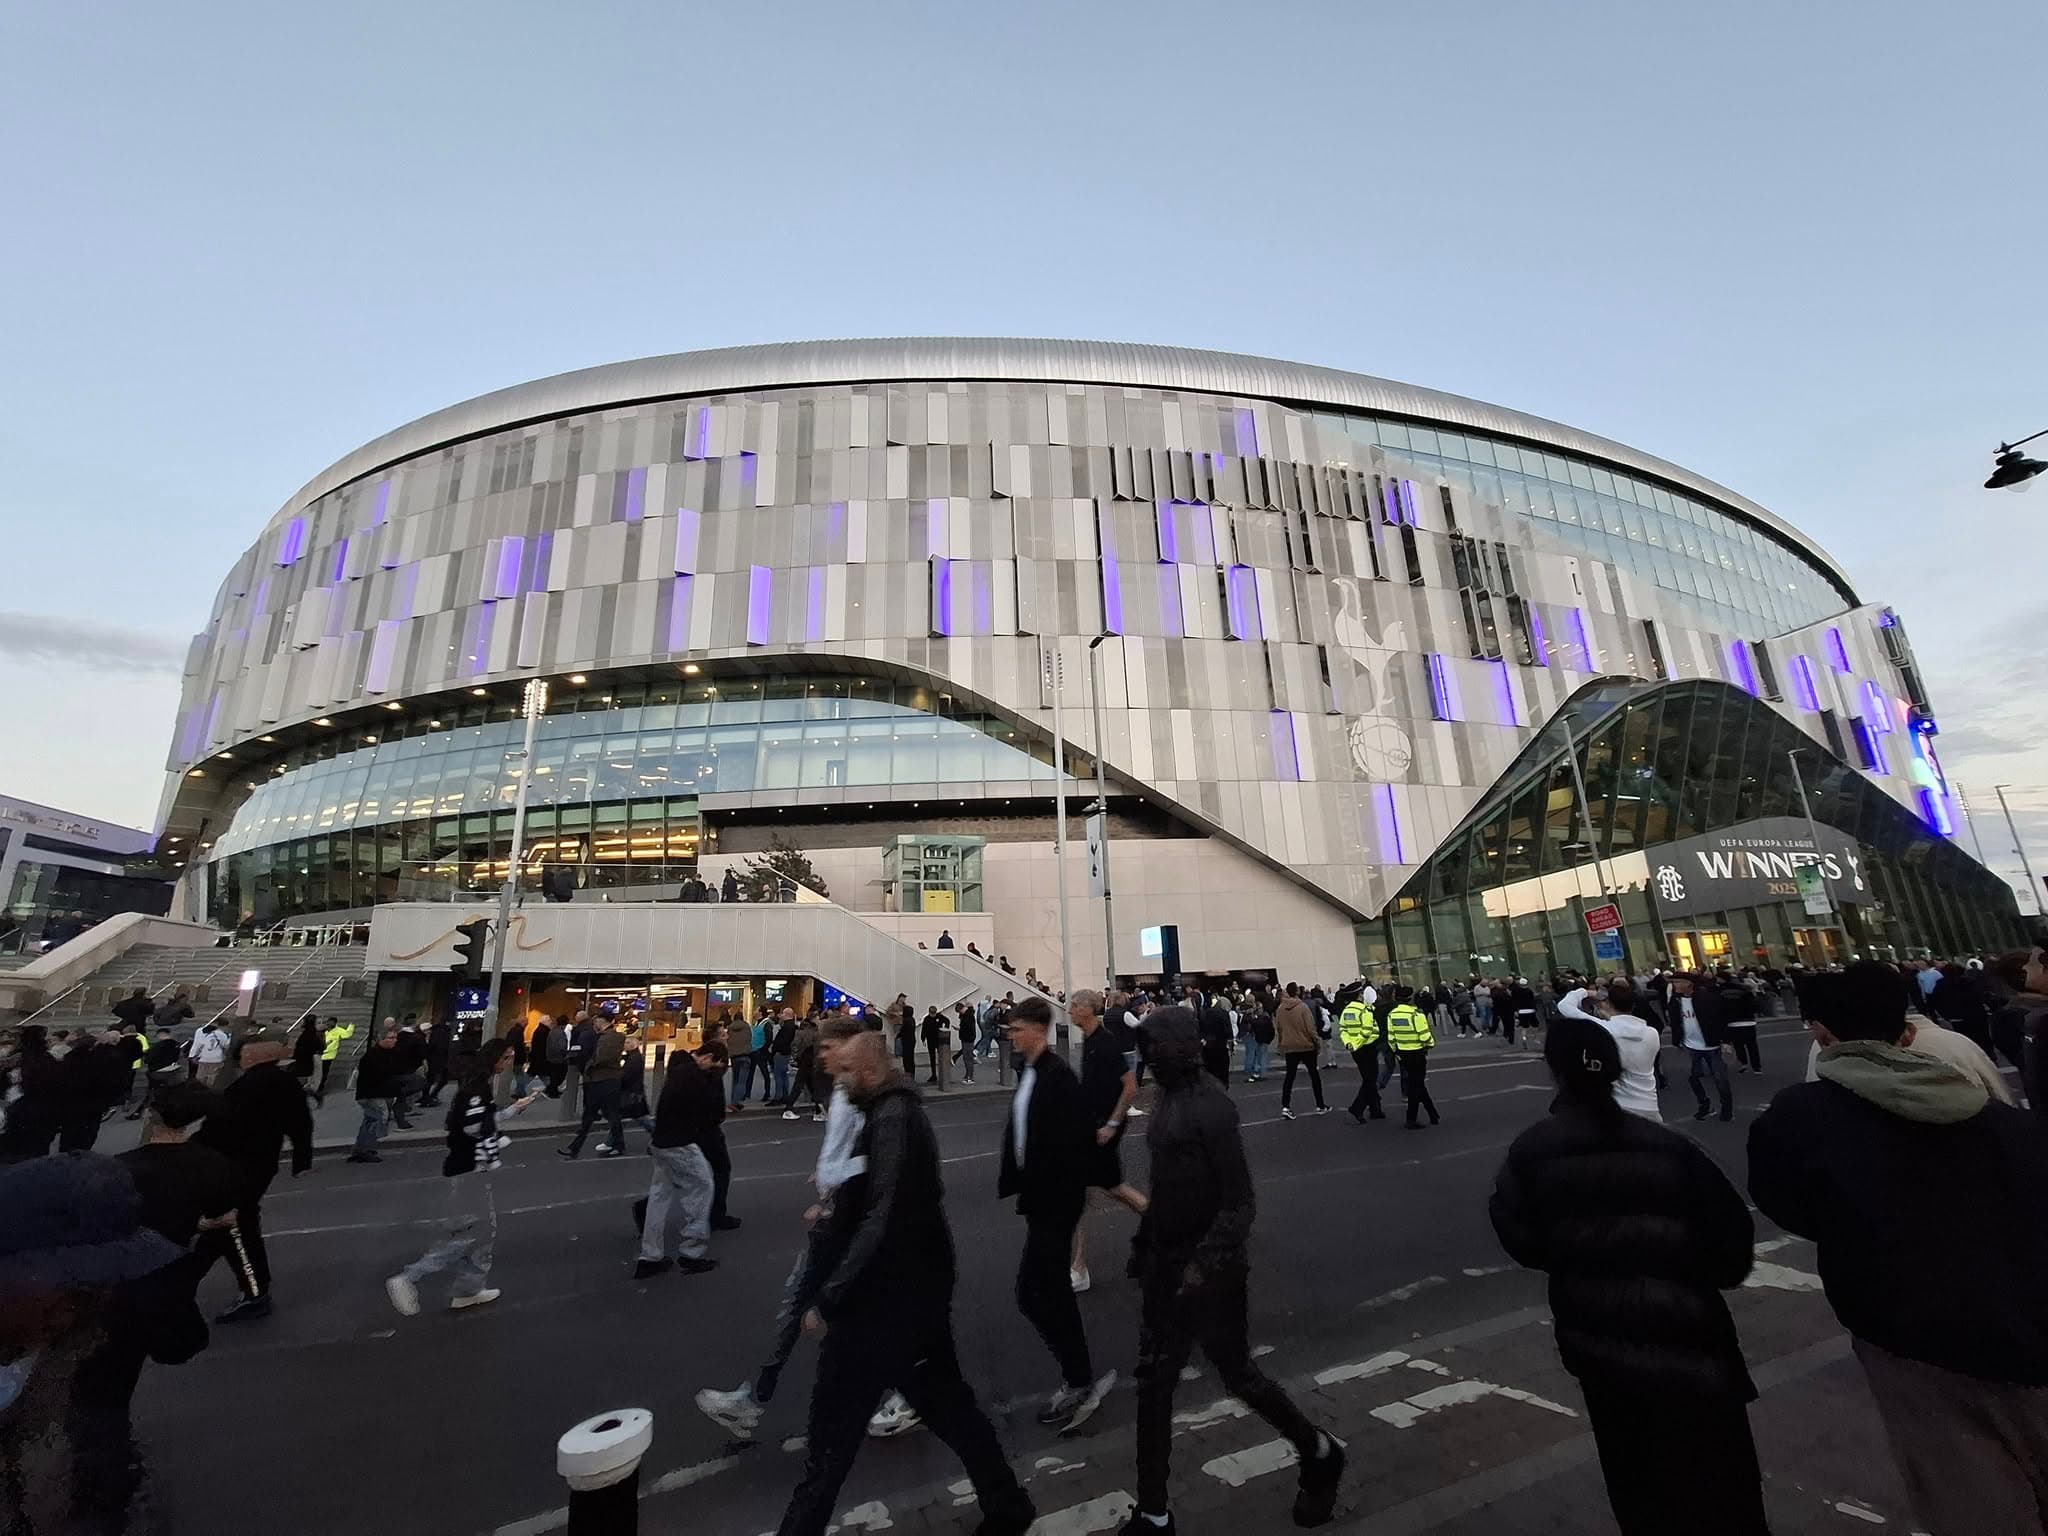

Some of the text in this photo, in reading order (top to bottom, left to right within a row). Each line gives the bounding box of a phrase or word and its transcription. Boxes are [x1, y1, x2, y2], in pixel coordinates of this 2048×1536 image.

[1719, 839, 1815, 849] UEFA EUROPA LEAGUE
[1766, 882, 1798, 895] 2025
